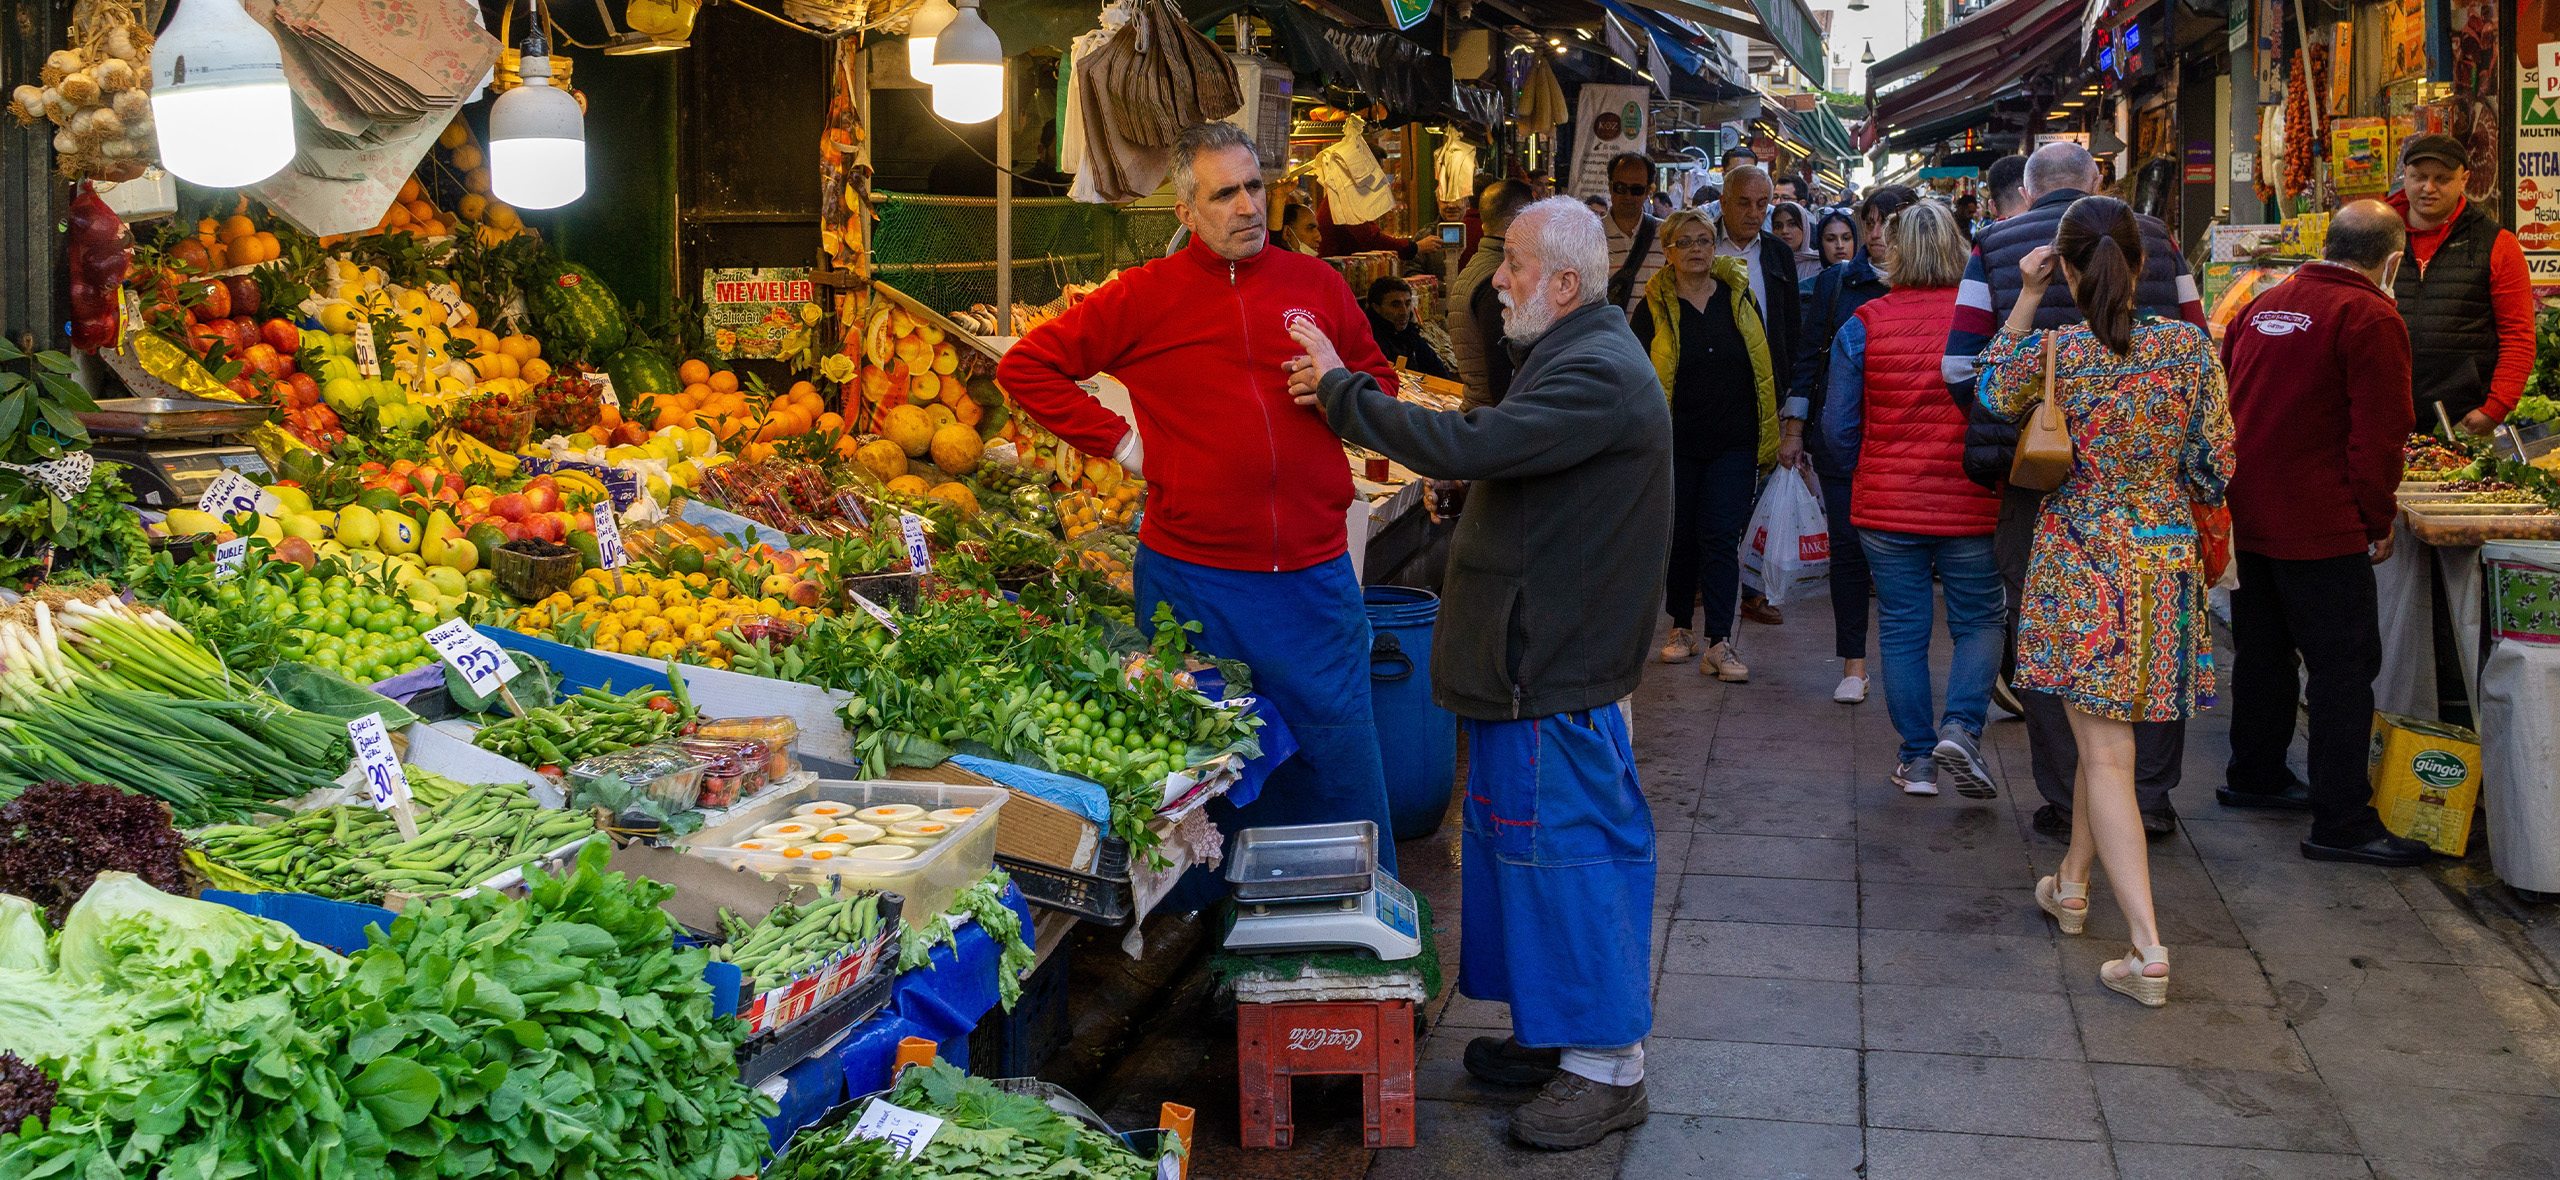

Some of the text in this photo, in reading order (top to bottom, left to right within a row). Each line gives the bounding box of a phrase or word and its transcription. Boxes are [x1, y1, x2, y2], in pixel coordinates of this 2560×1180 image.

[2517, 187, 2554, 200] Edenred
[201, 478, 226, 513] SANTA
[216, 474, 240, 510] ARMUT
[217, 544, 244, 561] DUBLE
[910, 544, 925, 568] 30
[457, 646, 500, 684] 25
[350, 718, 376, 739] SAKIZ
[357, 731, 382, 754] BAKLA
[2415, 759, 2465, 778] güngör
[368, 763, 393, 803] 30
[1286, 1028, 1363, 1051] Coca-Cola
